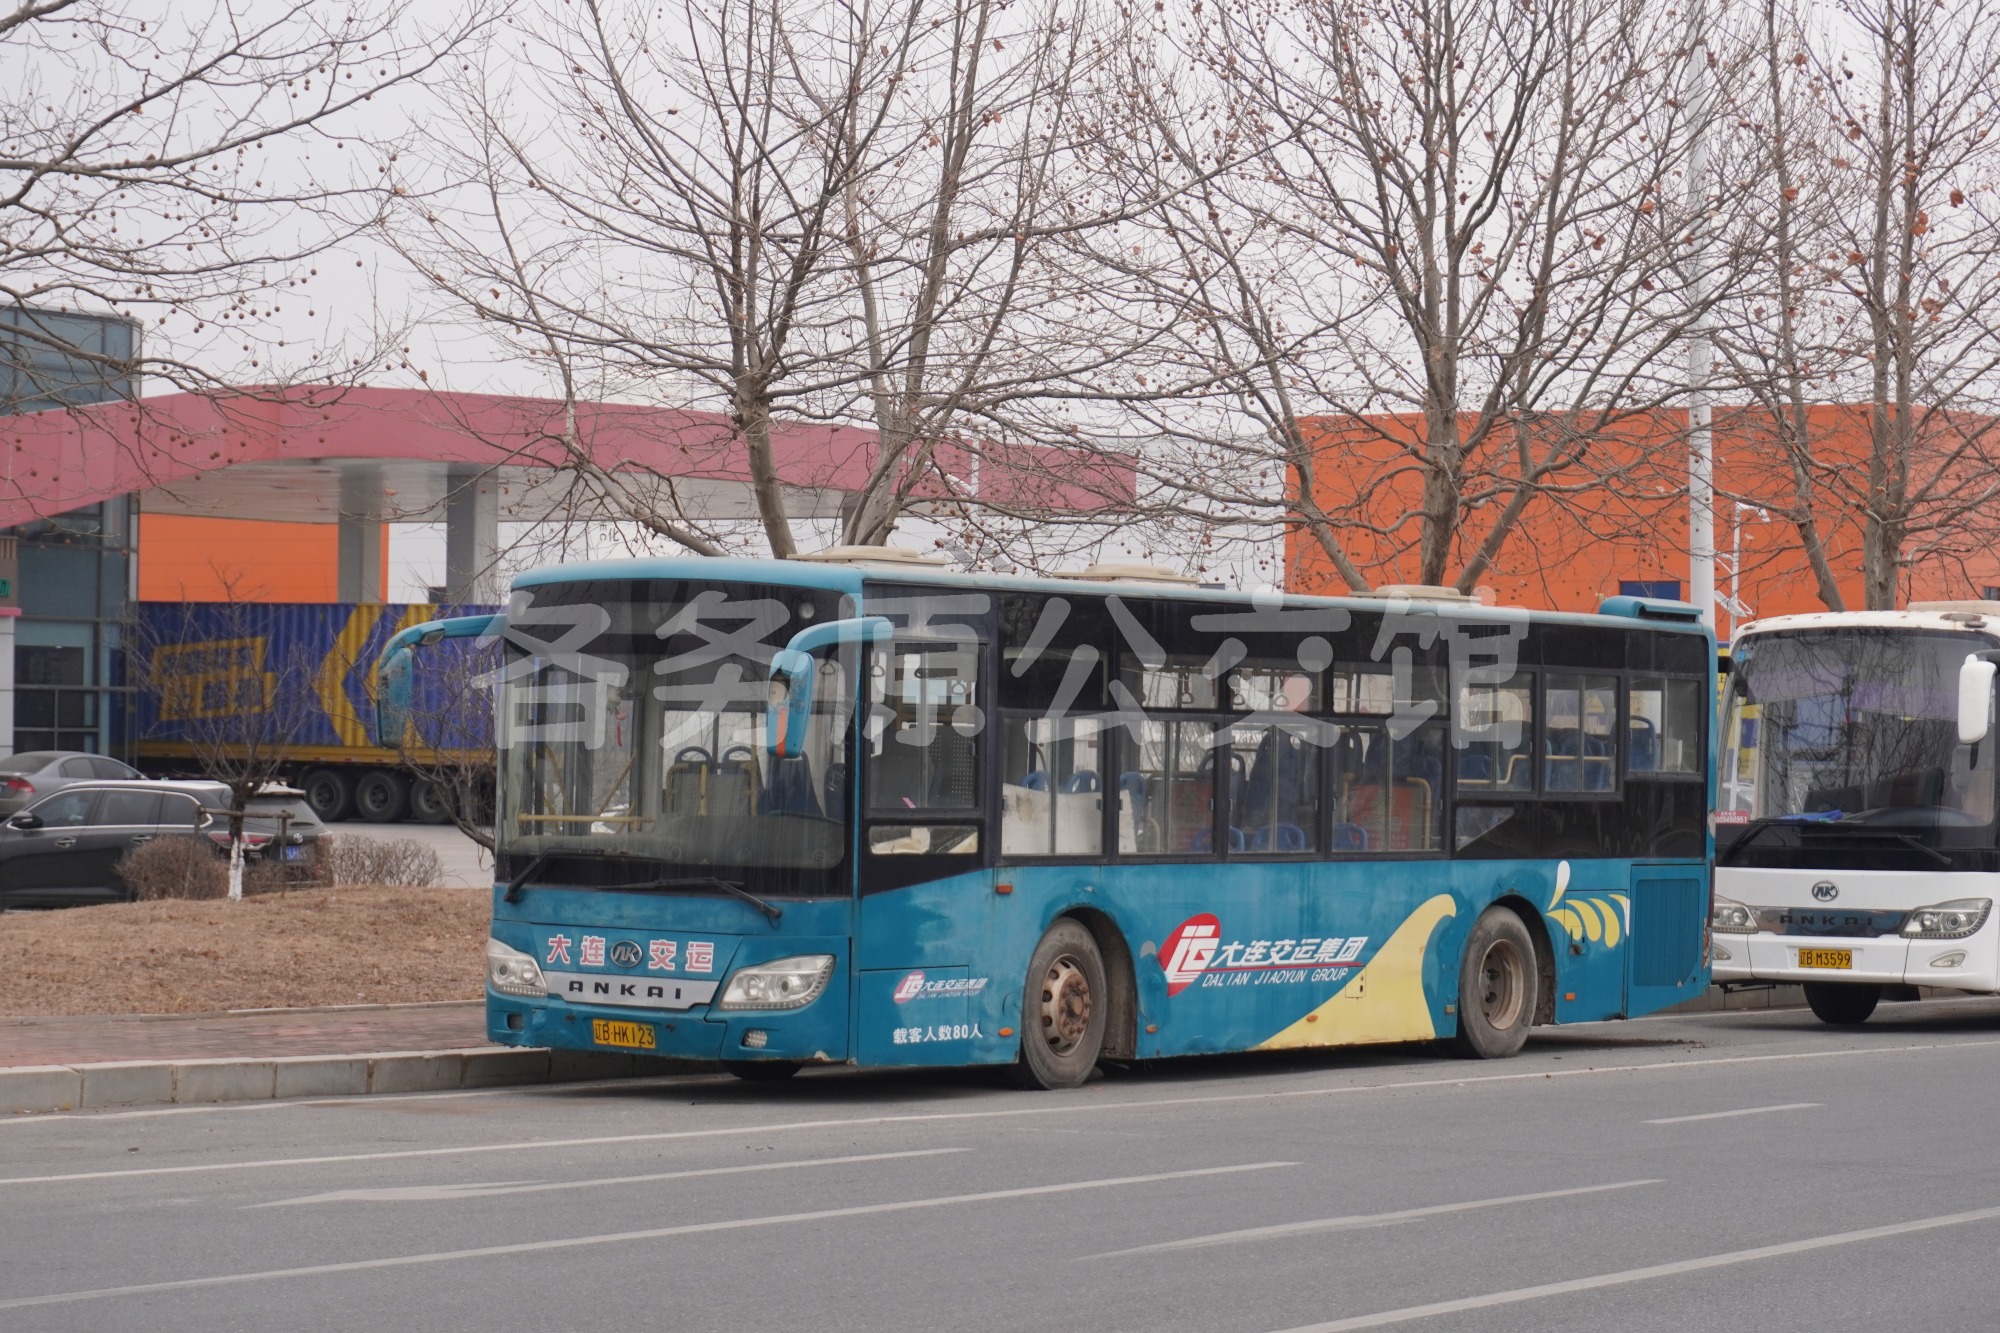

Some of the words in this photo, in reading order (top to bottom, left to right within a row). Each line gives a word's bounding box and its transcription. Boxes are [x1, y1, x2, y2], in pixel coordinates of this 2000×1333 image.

[1780, 915, 1873, 926] ANKAI
[547, 934, 606, 966] 大连
[648, 939, 714, 973] 交运
[1210, 936, 1369, 967] 大连交运集团
[1202, 972, 1251, 988] DALIAN
[1254, 969, 1308, 985] JIAOYUN
[1311, 967, 1348, 982] GROUP
[569, 980, 681, 999] ANKAI
[893, 1023, 983, 1045] 载客人数80人
